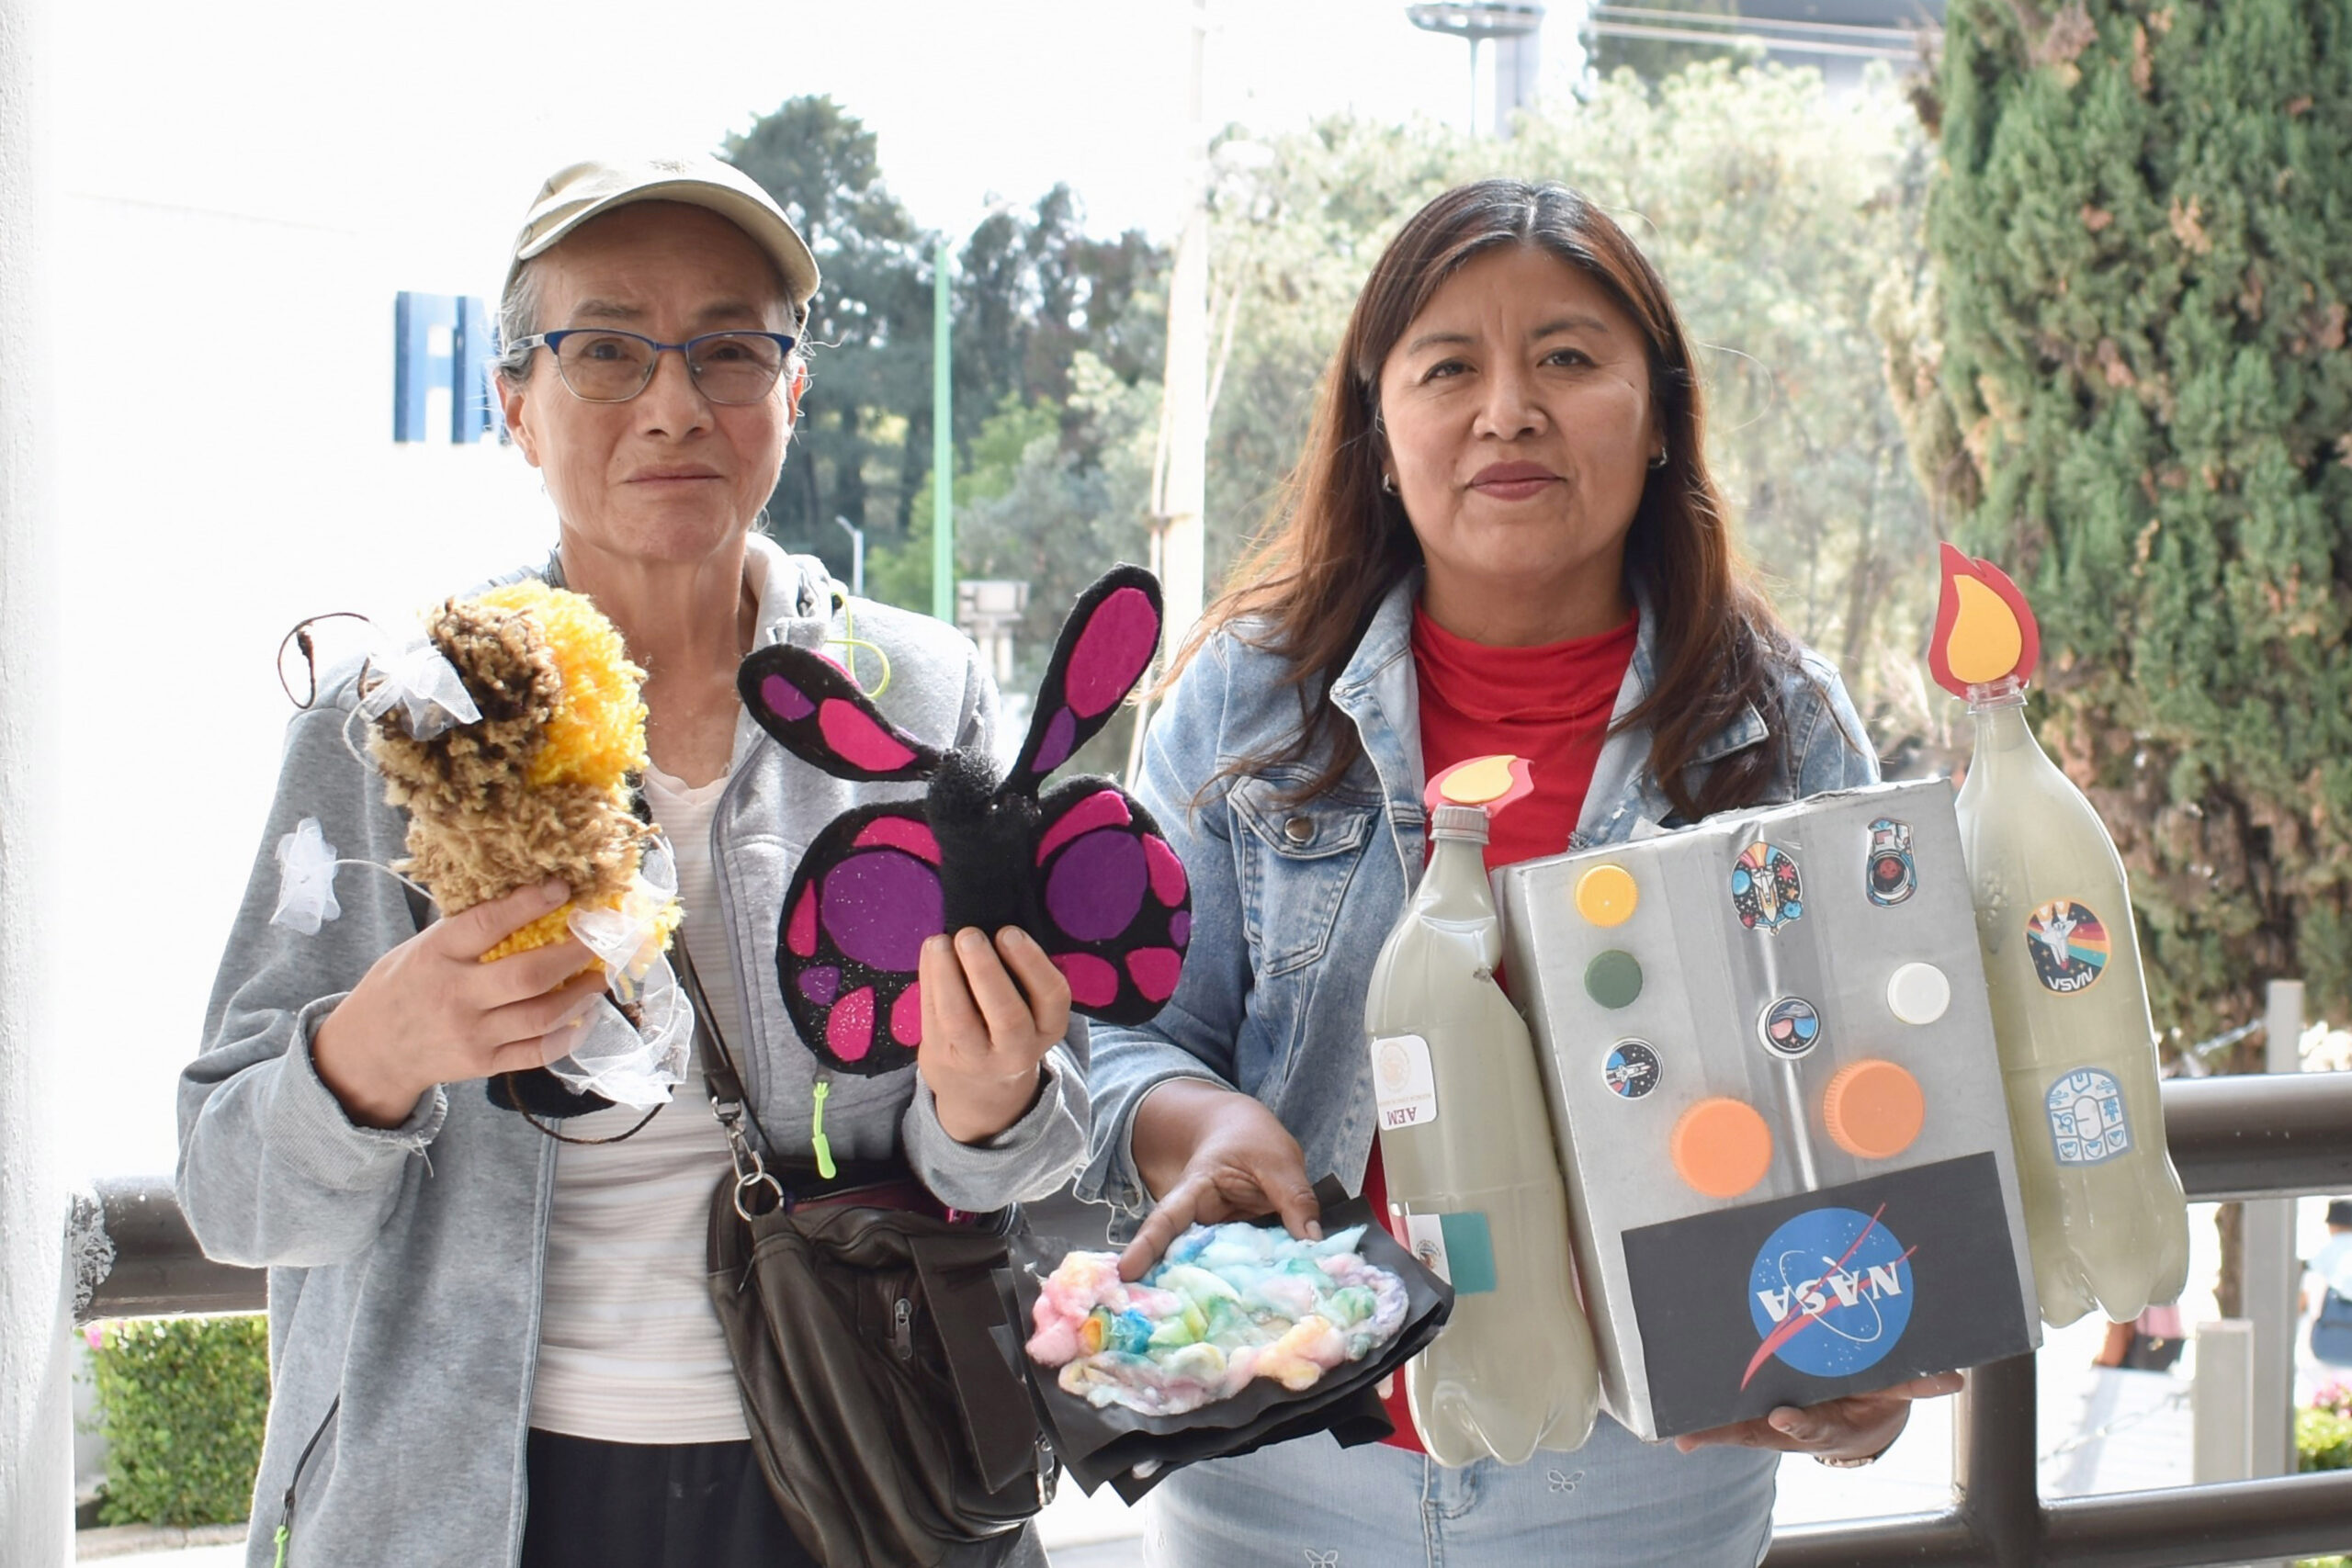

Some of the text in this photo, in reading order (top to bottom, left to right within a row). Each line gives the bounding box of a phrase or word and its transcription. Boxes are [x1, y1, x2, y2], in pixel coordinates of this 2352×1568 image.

[2048, 967, 2093, 991] NASA
[1387, 1108, 1417, 1125] AEM
[1756, 1262, 1903, 1323] NASA
